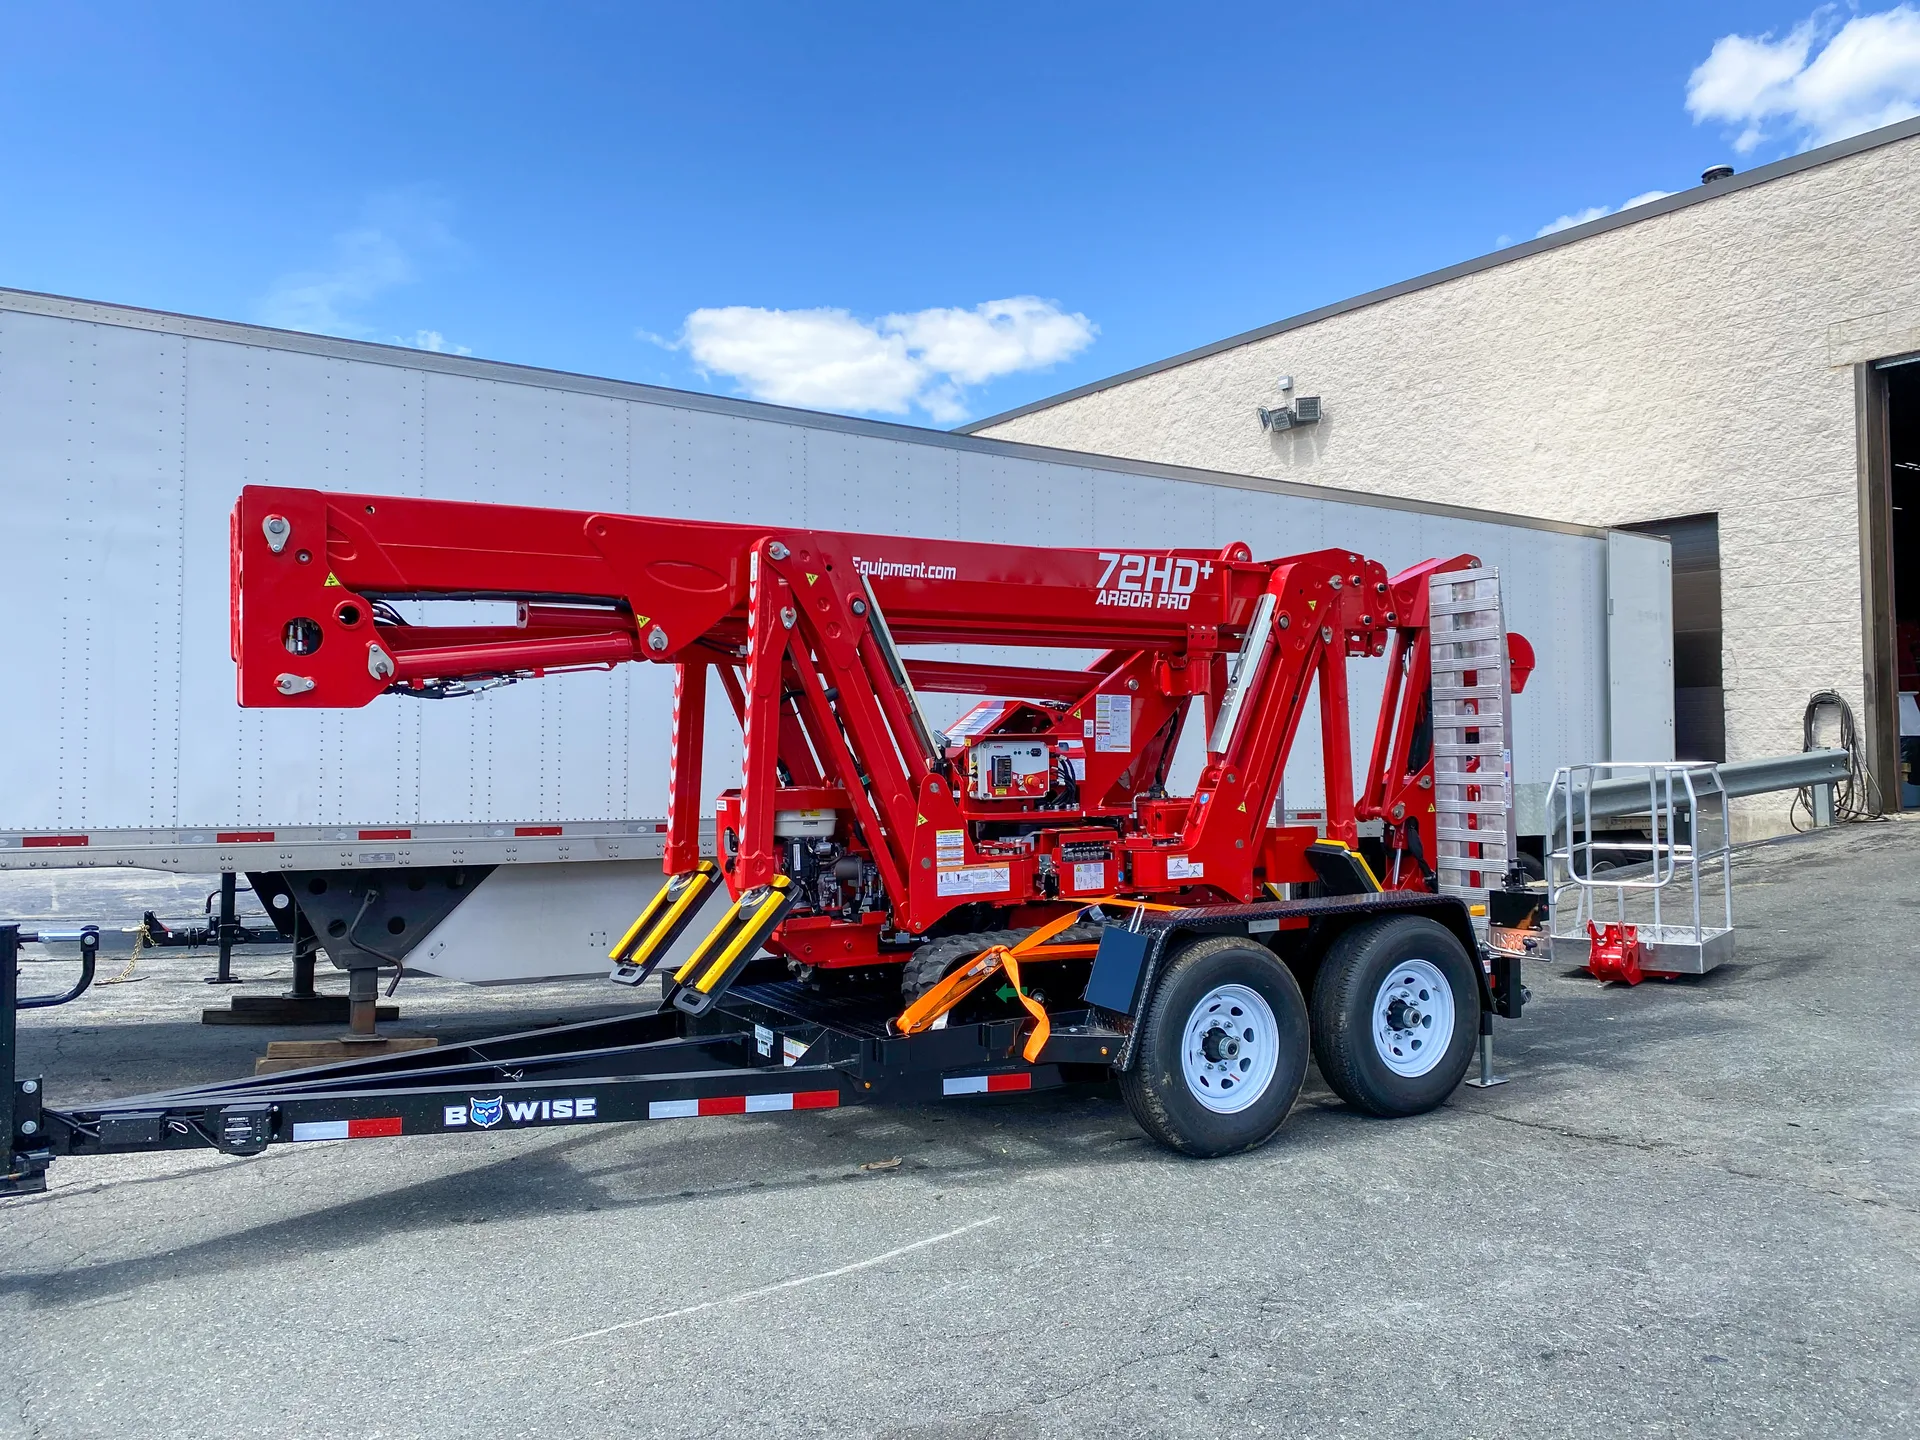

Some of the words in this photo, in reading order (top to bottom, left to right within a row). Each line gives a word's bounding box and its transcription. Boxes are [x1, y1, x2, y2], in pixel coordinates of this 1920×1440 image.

[1096, 552, 1214, 594] 72HD+
[1095, 589, 1153, 608] ARBOR
[1156, 593, 1191, 610] PRO
